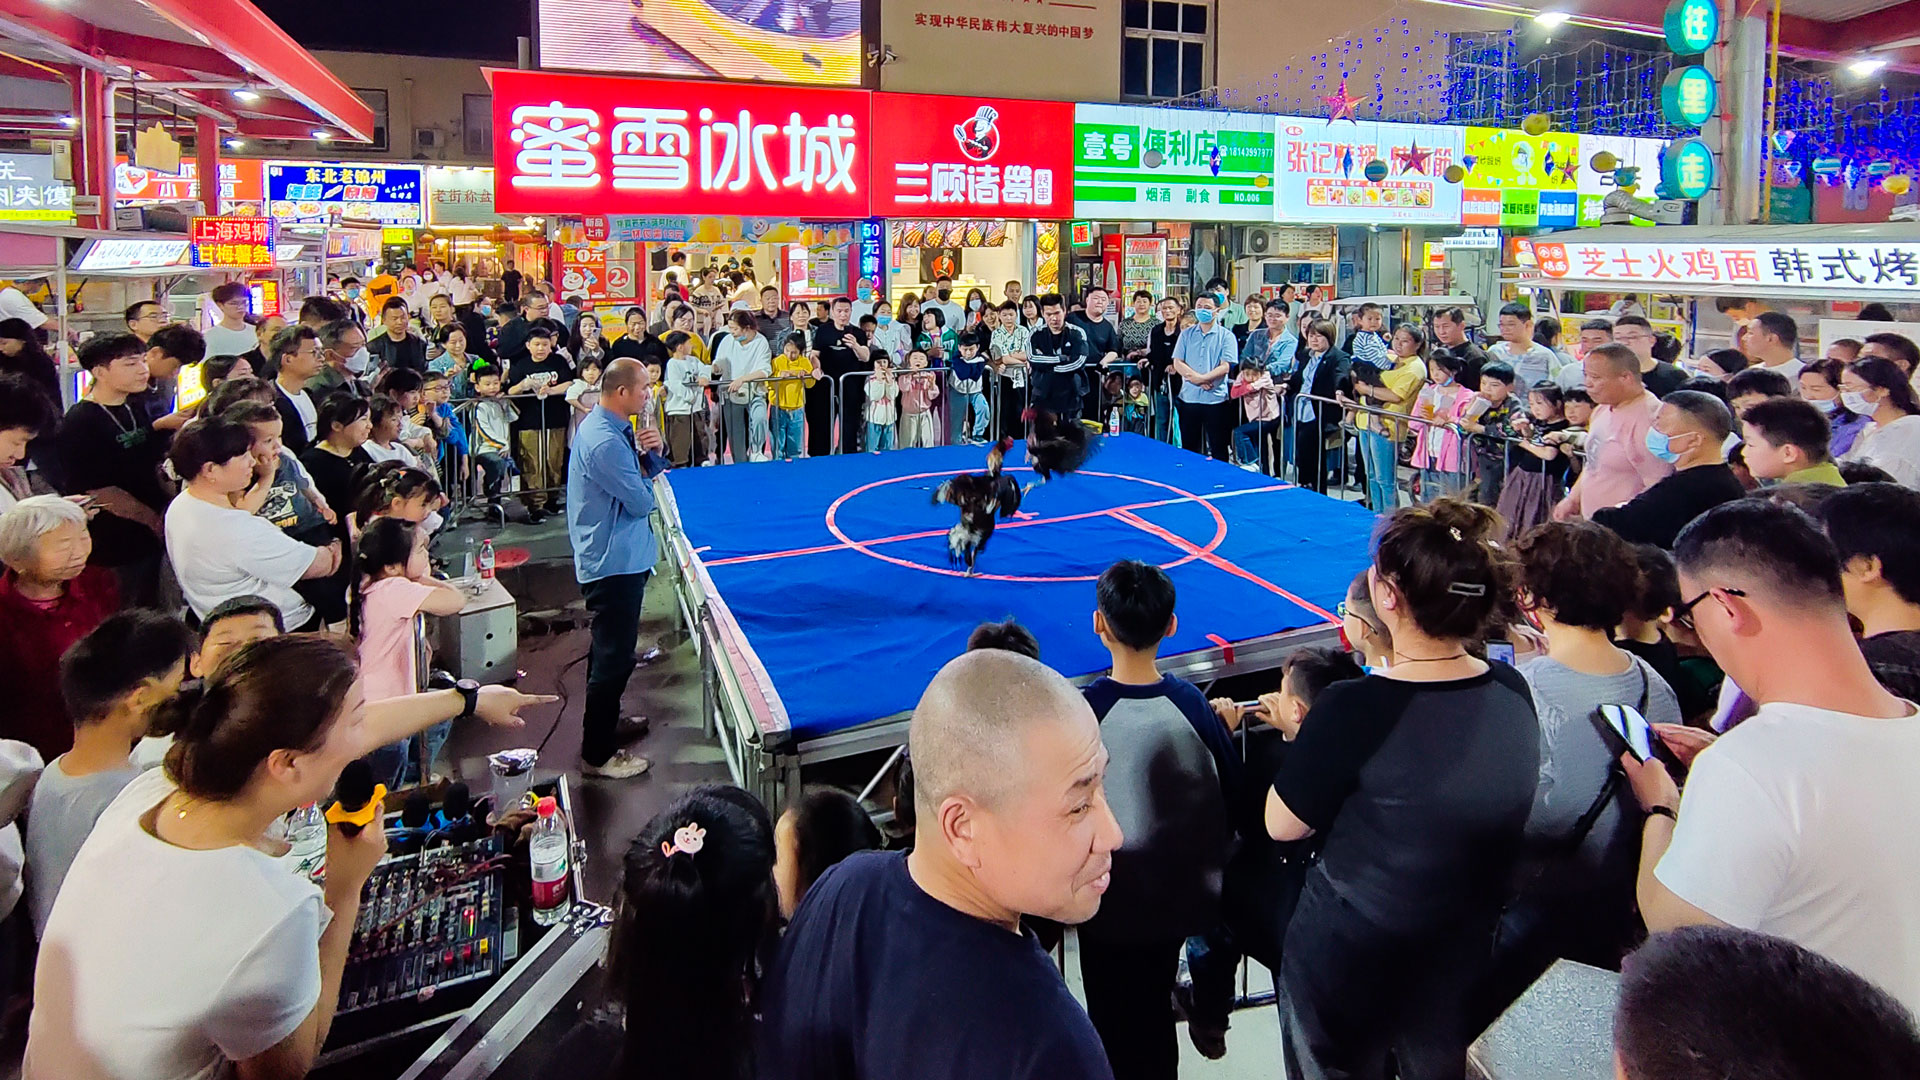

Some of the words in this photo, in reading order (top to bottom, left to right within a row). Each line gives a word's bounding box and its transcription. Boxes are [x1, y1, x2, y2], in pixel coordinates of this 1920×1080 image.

[914, 13, 1094, 39] 实现中华民族伟大复兴的中国梦
[511, 101, 856, 192] 蜜雪冰城
[1083, 132, 1133, 161] 壹号
[305, 168, 386, 184] 东北老锦州
[895, 162, 1032, 204] 三顾诸葛
[1146, 187, 1171, 202] 烟酒
[1185, 188, 1211, 204] 副食
[1233, 192, 1260, 203] NO.006
[197, 221, 269, 242] 上海鸡柳
[585, 218, 603, 227] 新品
[586, 228, 603, 238] 上市
[198, 243, 270, 264] 甘梅薯条
[1578, 247, 1760, 281] 芝士火鸡面
[1768, 247, 1919, 286] 韩式烤
